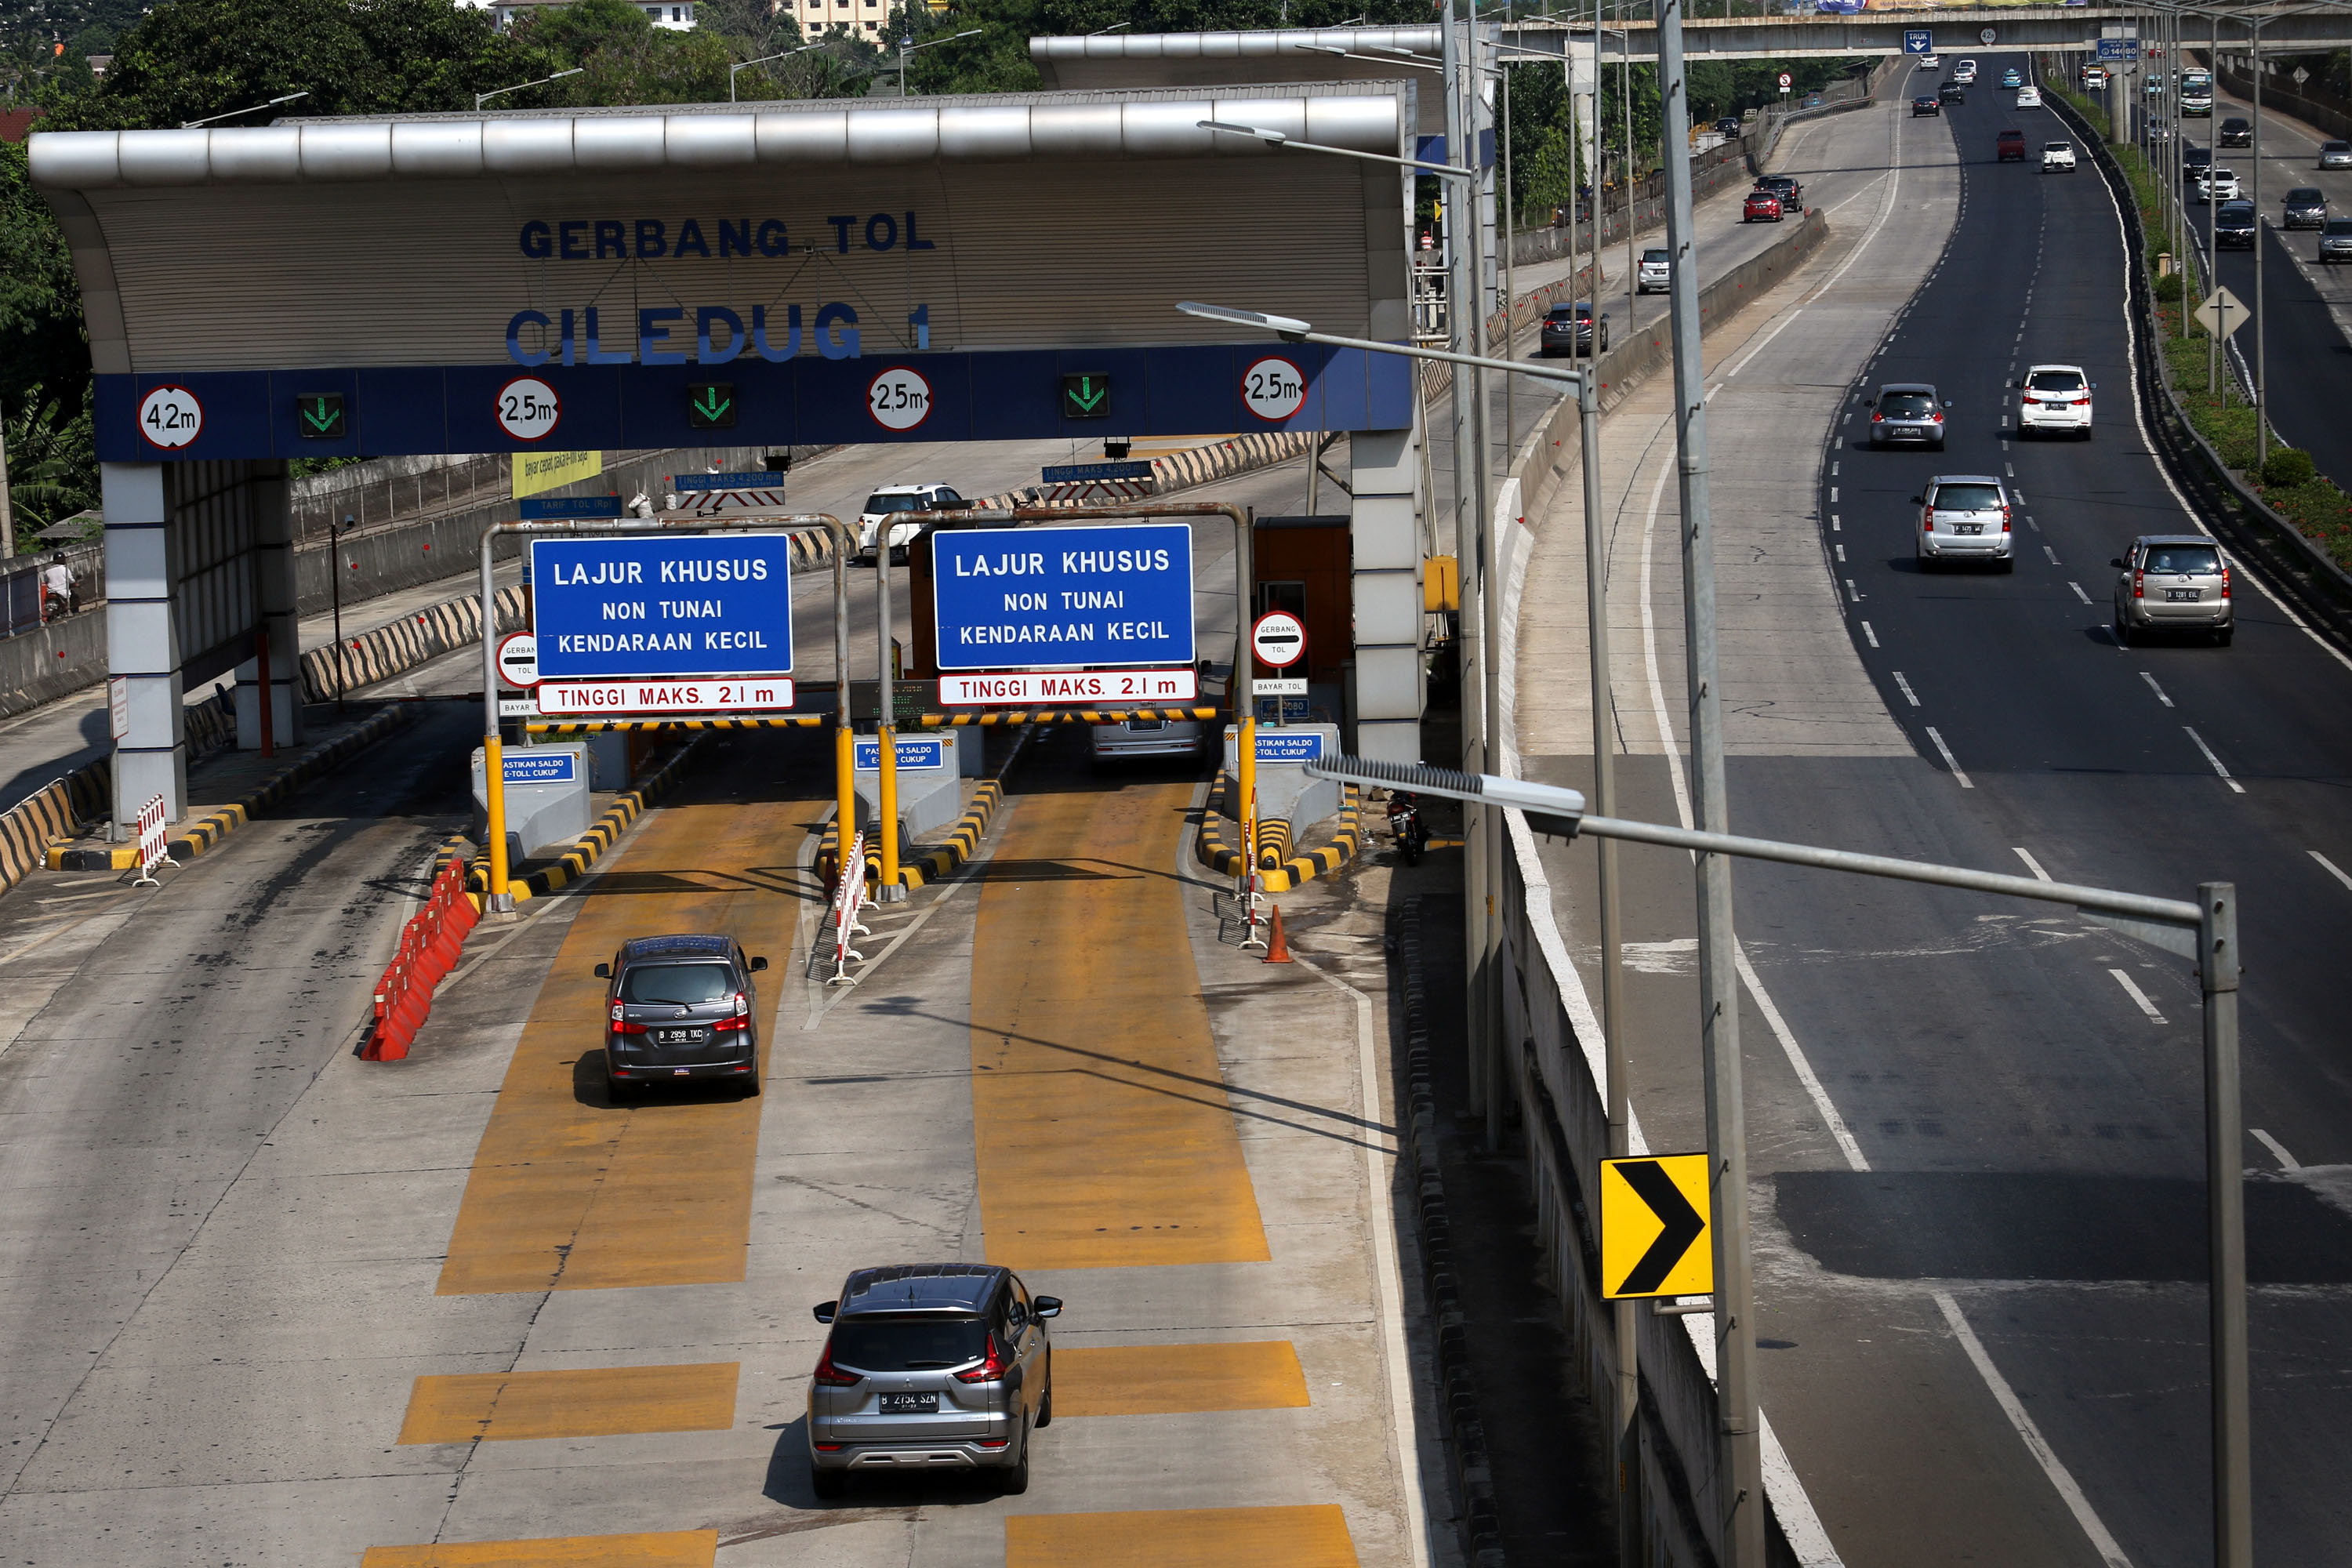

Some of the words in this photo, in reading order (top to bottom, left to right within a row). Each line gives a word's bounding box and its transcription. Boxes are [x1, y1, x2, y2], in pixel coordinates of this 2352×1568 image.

[521, 219, 789, 260] GERBANG
[827, 212, 936, 253] TOL
[506, 302, 861, 367] CILEDUG
[909, 304, 929, 350] 1
[877, 383, 922, 412] 2,5m
[1251, 373, 1296, 402] 2,5m
[147, 403, 195, 432] 4,2m
[505, 395, 551, 423] 2,5m
[678, 476, 706, 485] TINGGI
[710, 474, 735, 483] MAKS
[739, 474, 764, 482] 4.200
[1046, 467, 1073, 476] TINGGI
[1077, 465, 1102, 474] MAKS
[541, 500, 565, 510] TARIF
[572, 499, 590, 509] TOL
[593, 499, 612, 510] (Rp)
[554, 562, 643, 585] LAJUR
[661, 559, 768, 583] KHUSUS
[956, 553, 1044, 576] LAJUR
[1062, 549, 1170, 574] KHUSUS
[602, 601, 645, 620] NON
[659, 600, 722, 619] TUNAI
[1004, 593, 1047, 612] NON
[1062, 590, 1123, 609] TUNAI
[559, 633, 691, 652] KENDARAAN
[706, 631, 768, 649] KECIL
[960, 623, 1094, 644] KENDARAAN
[1108, 621, 1170, 640] KECIL
[558, 688, 625, 706] TINGGI
[640, 687, 703, 705] MAKS.
[719, 686, 744, 703] 2.1
[755, 688, 774, 702] m
[960, 680, 1027, 698] TINGGI
[1042, 677, 1105, 695] MAKS.
[1121, 677, 1146, 695] 2.1
[1158, 680, 1176, 694] m
[660, 1030, 665, 1039] B
[690, 1029, 702, 1038] TKC
[882, 1396, 887, 1404] B
[894, 1394, 915, 1404] 2754
[920, 1393, 936, 1403] SZN
